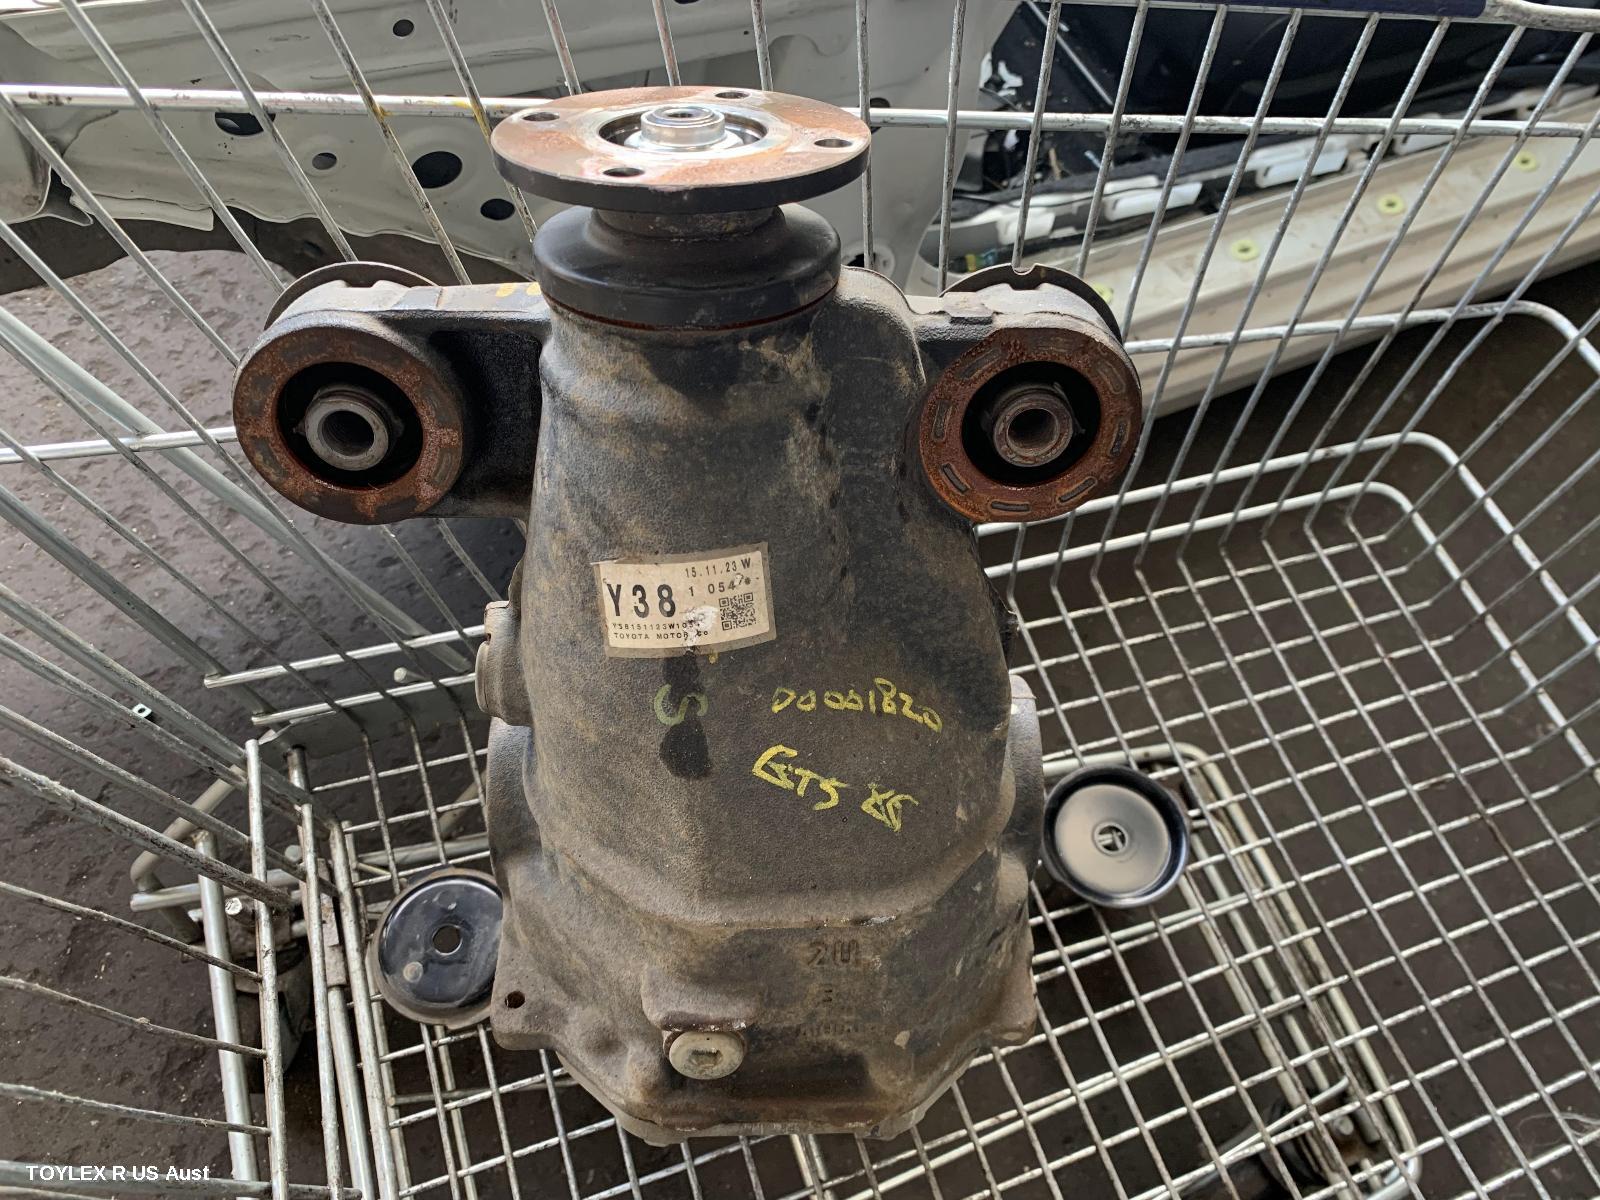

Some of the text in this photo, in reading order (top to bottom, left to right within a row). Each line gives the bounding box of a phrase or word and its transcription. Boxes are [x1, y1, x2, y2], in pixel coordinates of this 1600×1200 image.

[685, 557, 751, 578] 15.11.23 W
[688, 586, 694, 597] 1
[606, 583, 676, 619] Y38
[614, 632, 650, 640] TOYOTA
[656, 631, 689, 640] MOTOR
